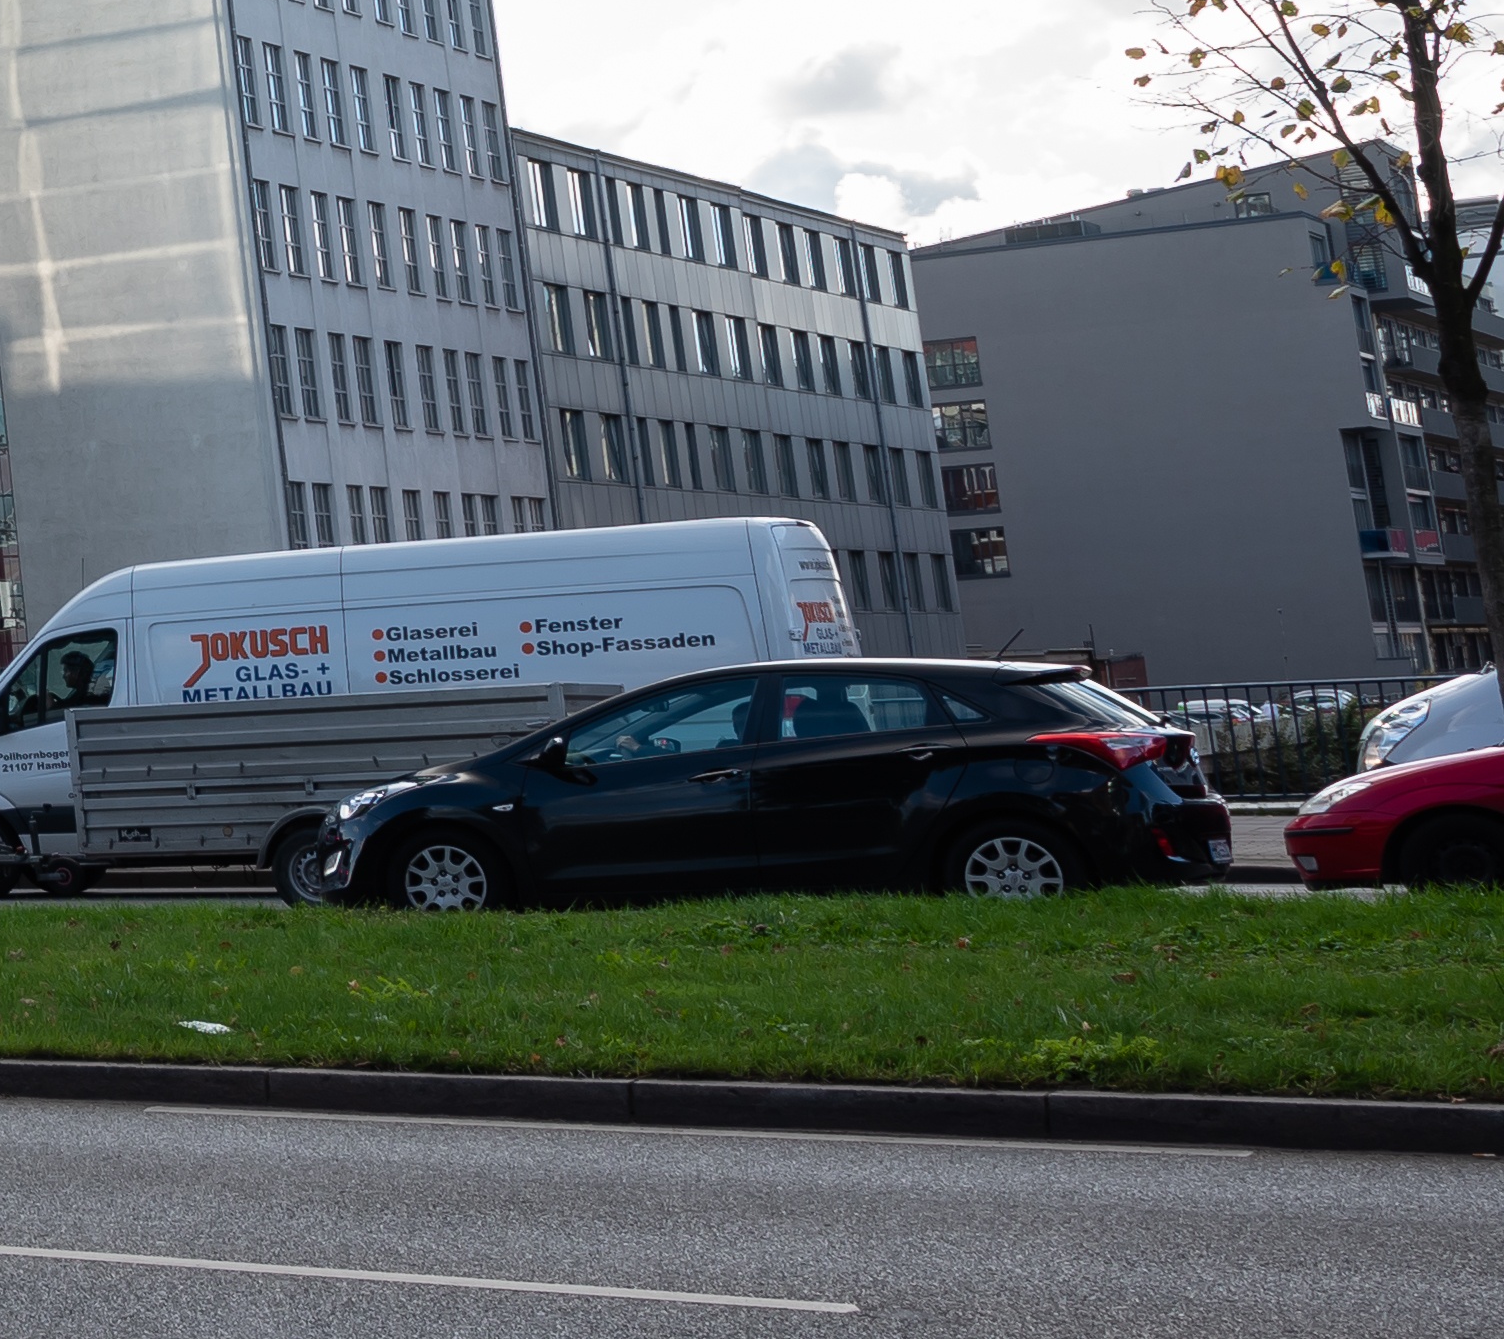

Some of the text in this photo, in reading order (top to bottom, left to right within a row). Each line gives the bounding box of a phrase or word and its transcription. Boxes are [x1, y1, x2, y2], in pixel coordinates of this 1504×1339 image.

[385, 621, 479, 642] Glaserei
[534, 615, 624, 634] Fenster
[387, 644, 498, 664] Metallbau
[536, 632, 717, 658] Shop-Fassaden
[182, 624, 330, 689] JOKUSCH
[235, 662, 309, 683] GLAS-
[389, 663, 521, 685] Schlosserei
[182, 680, 333, 703] METALLBAU
[1, 762, 34, 773] 21107
